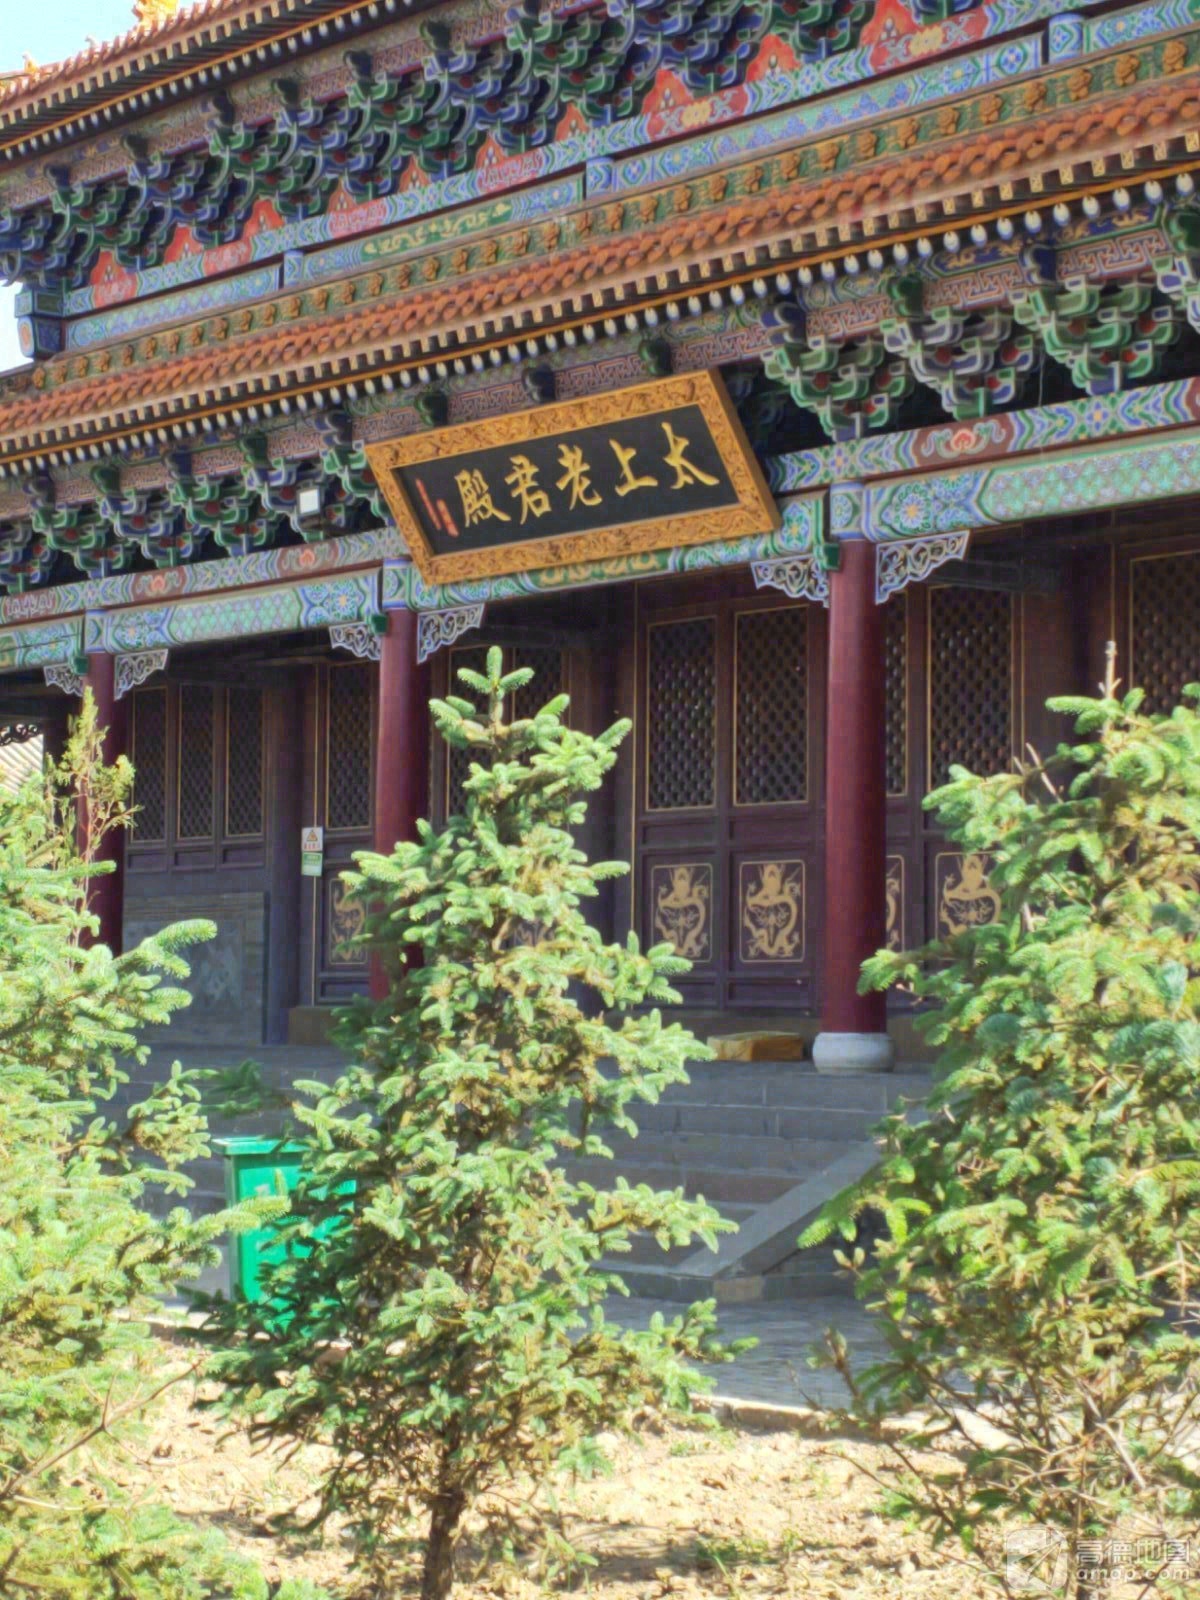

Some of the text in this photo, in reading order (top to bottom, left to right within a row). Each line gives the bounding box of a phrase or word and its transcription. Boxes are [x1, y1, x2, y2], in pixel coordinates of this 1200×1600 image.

[454, 421, 720, 528] 太上老君殿
